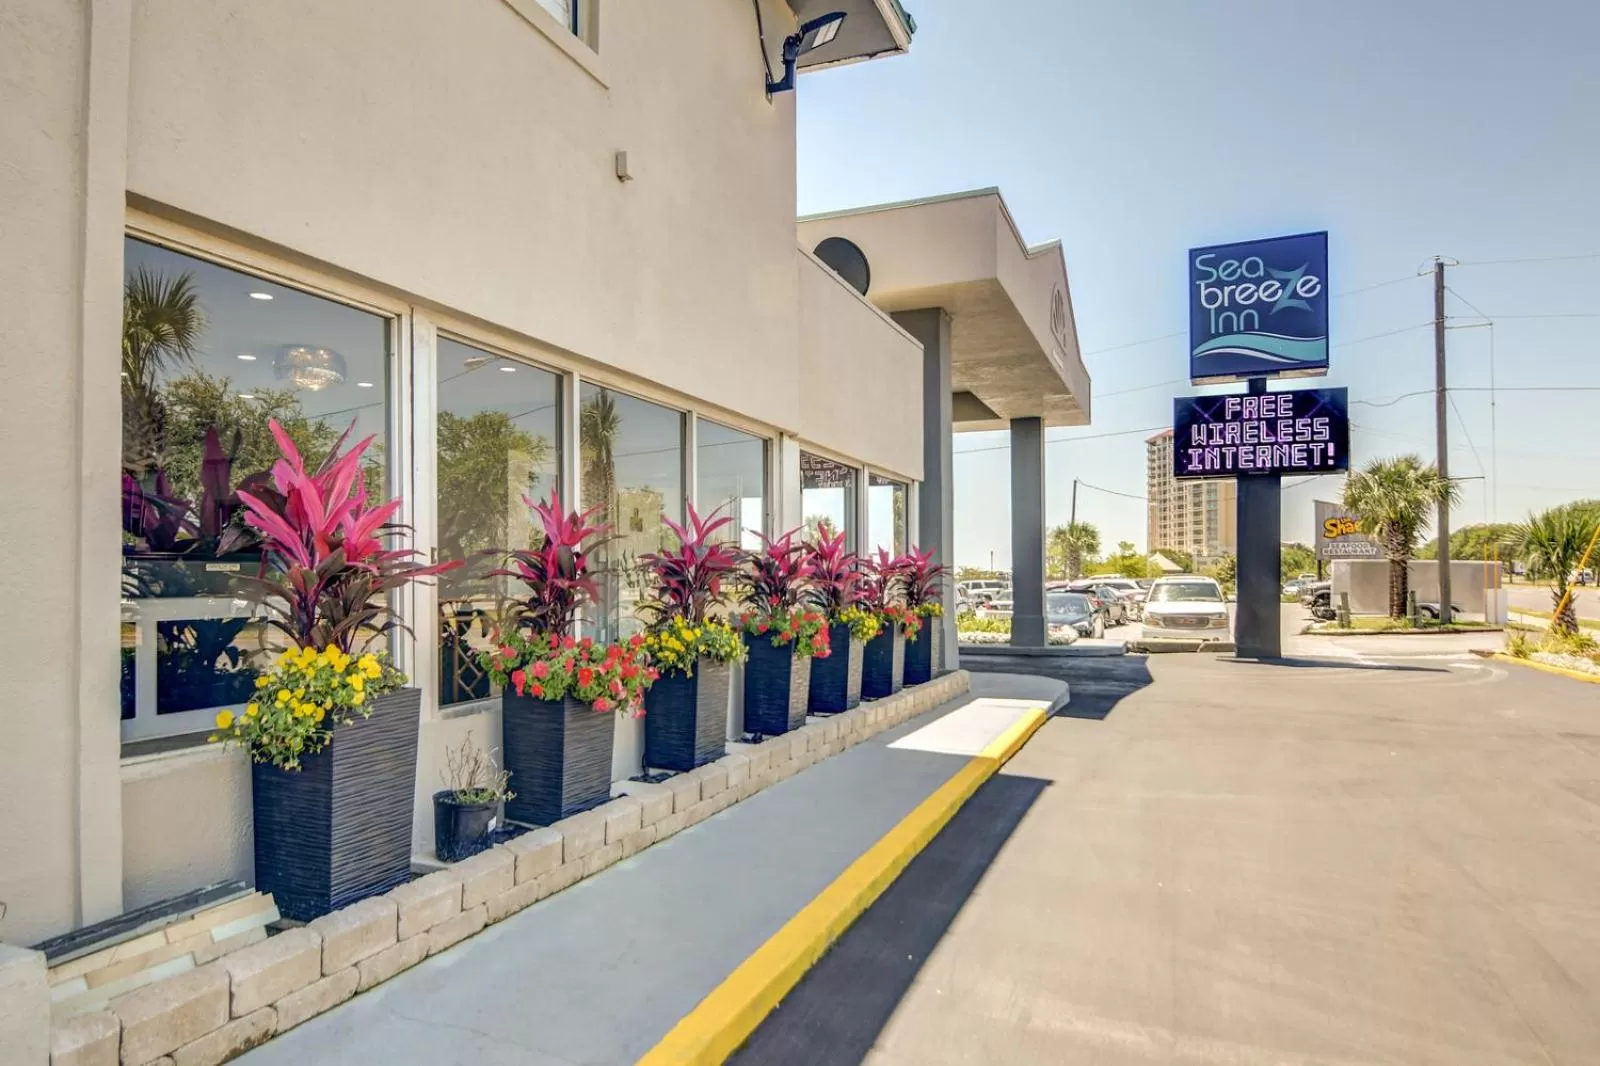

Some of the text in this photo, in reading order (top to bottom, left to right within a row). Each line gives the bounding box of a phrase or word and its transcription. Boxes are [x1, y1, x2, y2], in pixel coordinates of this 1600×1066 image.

[1195, 253, 1264, 285] Sea
[1210, 308, 1259, 334] Inn
[1225, 394, 1293, 420] FREE
[1191, 417, 1329, 446] WIRELESS
[1188, 442, 1335, 470] INTERNET!
